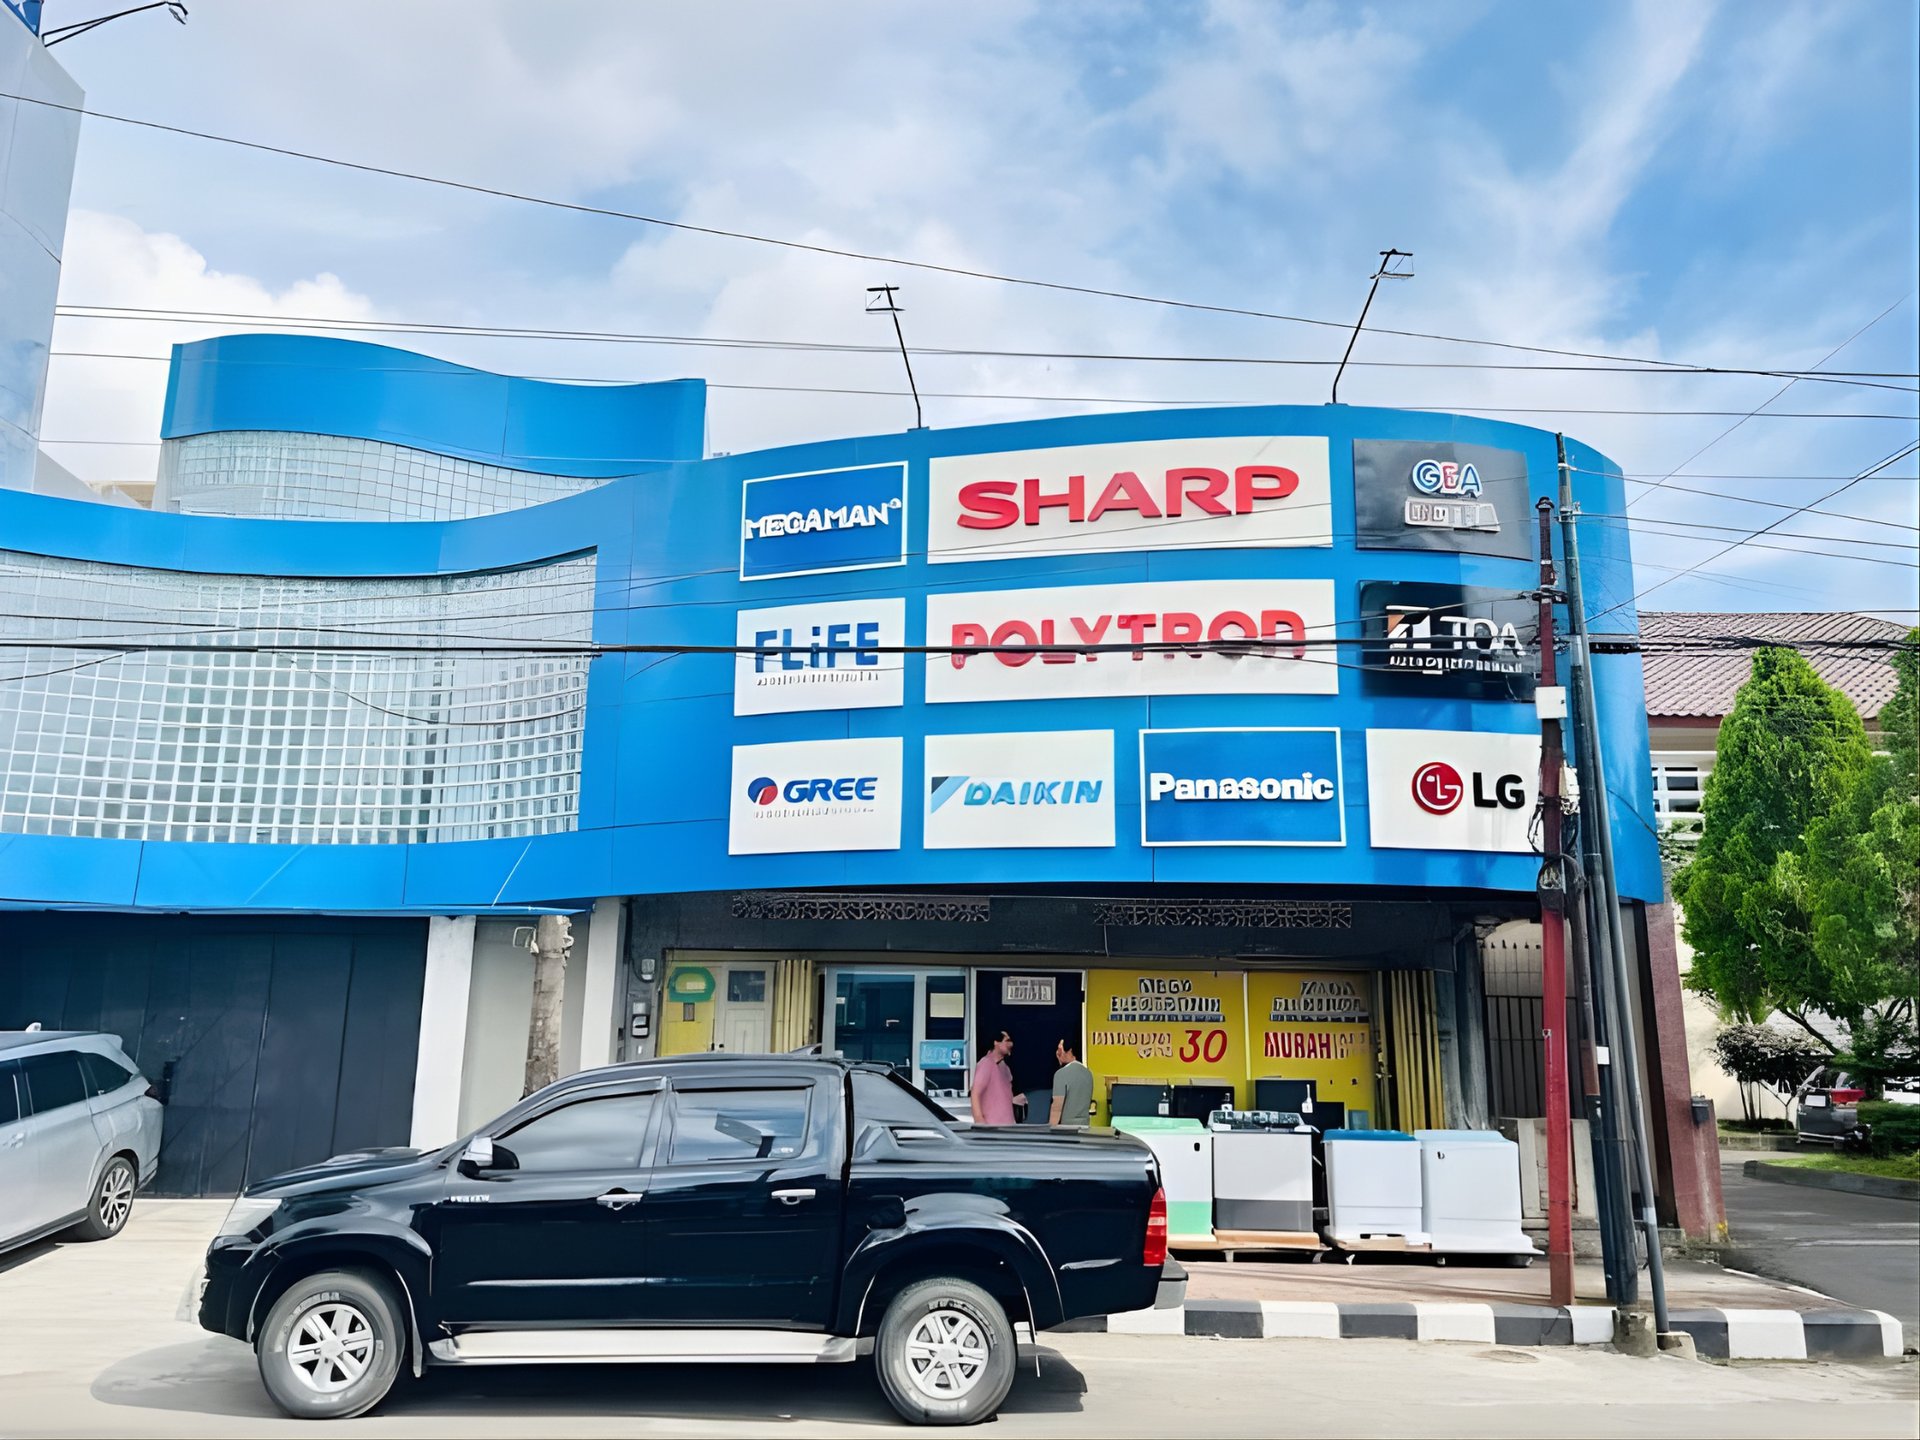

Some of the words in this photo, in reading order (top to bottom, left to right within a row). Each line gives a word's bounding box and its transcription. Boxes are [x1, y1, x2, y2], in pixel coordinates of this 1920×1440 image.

[957, 465, 1300, 530] SHARP
[783, 777, 878, 804] GREE
[963, 779, 1103, 807] DAIKIN
[1150, 771, 1334, 801] Panasonic
[1472, 771, 1526, 810] LG
[1179, 1029, 1228, 1063] 30
